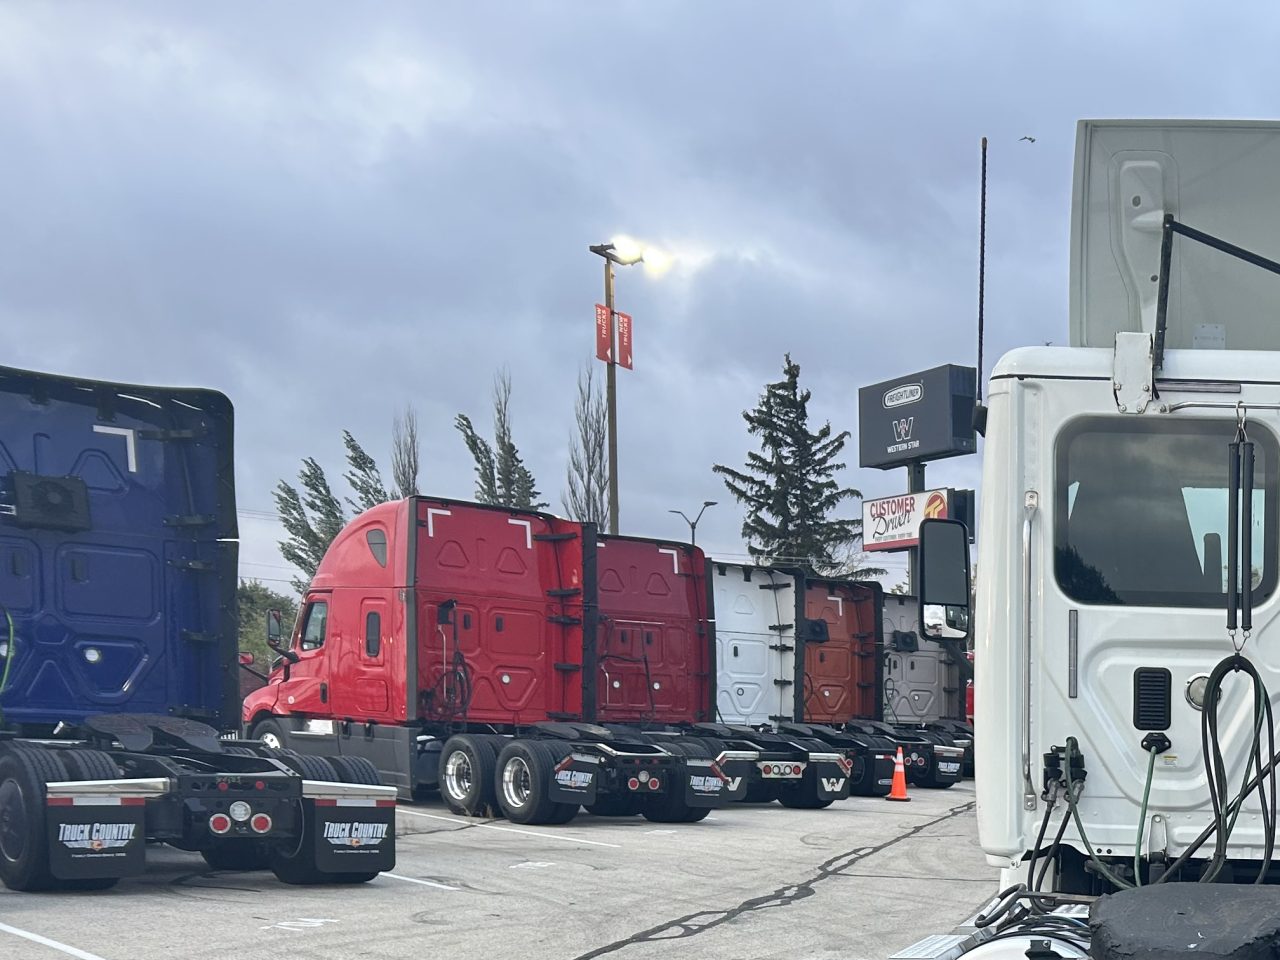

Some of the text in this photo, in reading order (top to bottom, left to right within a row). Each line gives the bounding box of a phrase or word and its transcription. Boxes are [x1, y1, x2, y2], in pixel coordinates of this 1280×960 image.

[870, 496, 915, 518] CUSTOMER
[873, 510, 911, 539] Driven
[59, 823, 135, 841] TRUCK COUNTRY
[323, 821, 388, 838] TRUCK COUNTRY
